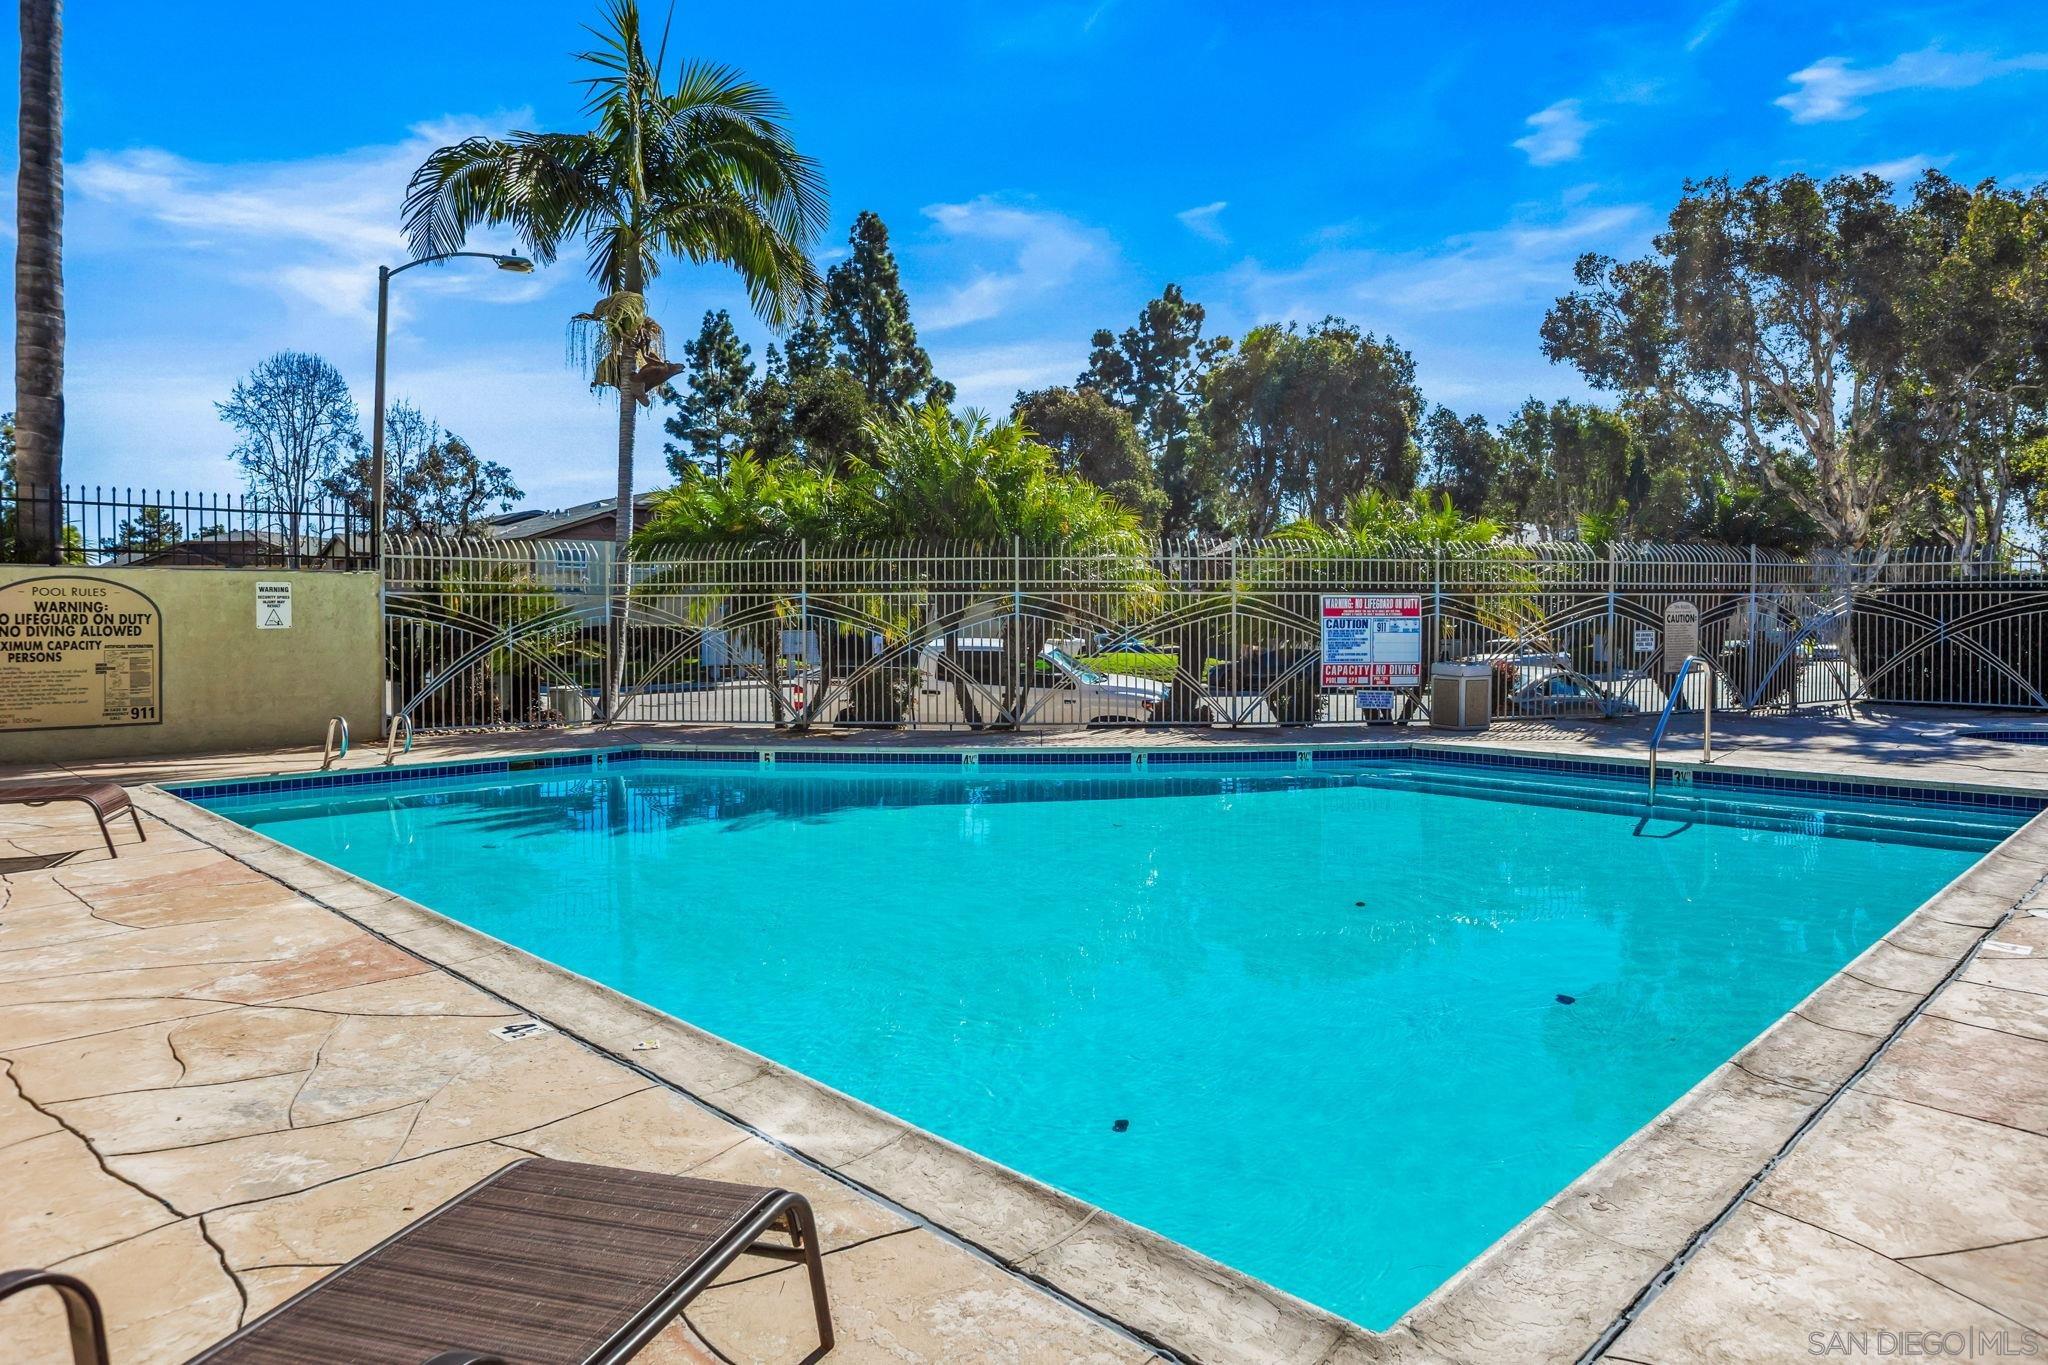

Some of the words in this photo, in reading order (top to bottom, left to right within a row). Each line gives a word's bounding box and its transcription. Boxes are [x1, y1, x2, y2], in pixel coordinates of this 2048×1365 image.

[32, 587, 66, 597] POOL
[71, 587, 107, 597] RULES
[34, 601, 109, 613] WARNING:
[1364, 598, 1394, 609] LIFEGUARD
[1403, 598, 1419, 609] DUTY
[15, 614, 88, 625] LIFEGUARD
[93, 614, 114, 625] ON
[119, 613, 152, 625] DUTY
[1326, 619, 1369, 629] CAUTION
[0, 626, 20, 637] NO
[26, 625, 76, 637] DIVING
[80, 625, 142, 637] ALLOWED
[1376, 622, 1387, 632] 911
[0, 641, 43, 651] XIMUM
[47, 640, 102, 651] CAPACITY
[8, 652, 62, 663] PERSONS
[1325, 665, 1370, 676] CAPACITY
[1375, 664, 1387, 675] NO
[1389, 664, 1417, 675] DIVING
[131, 707, 155, 720] 911
